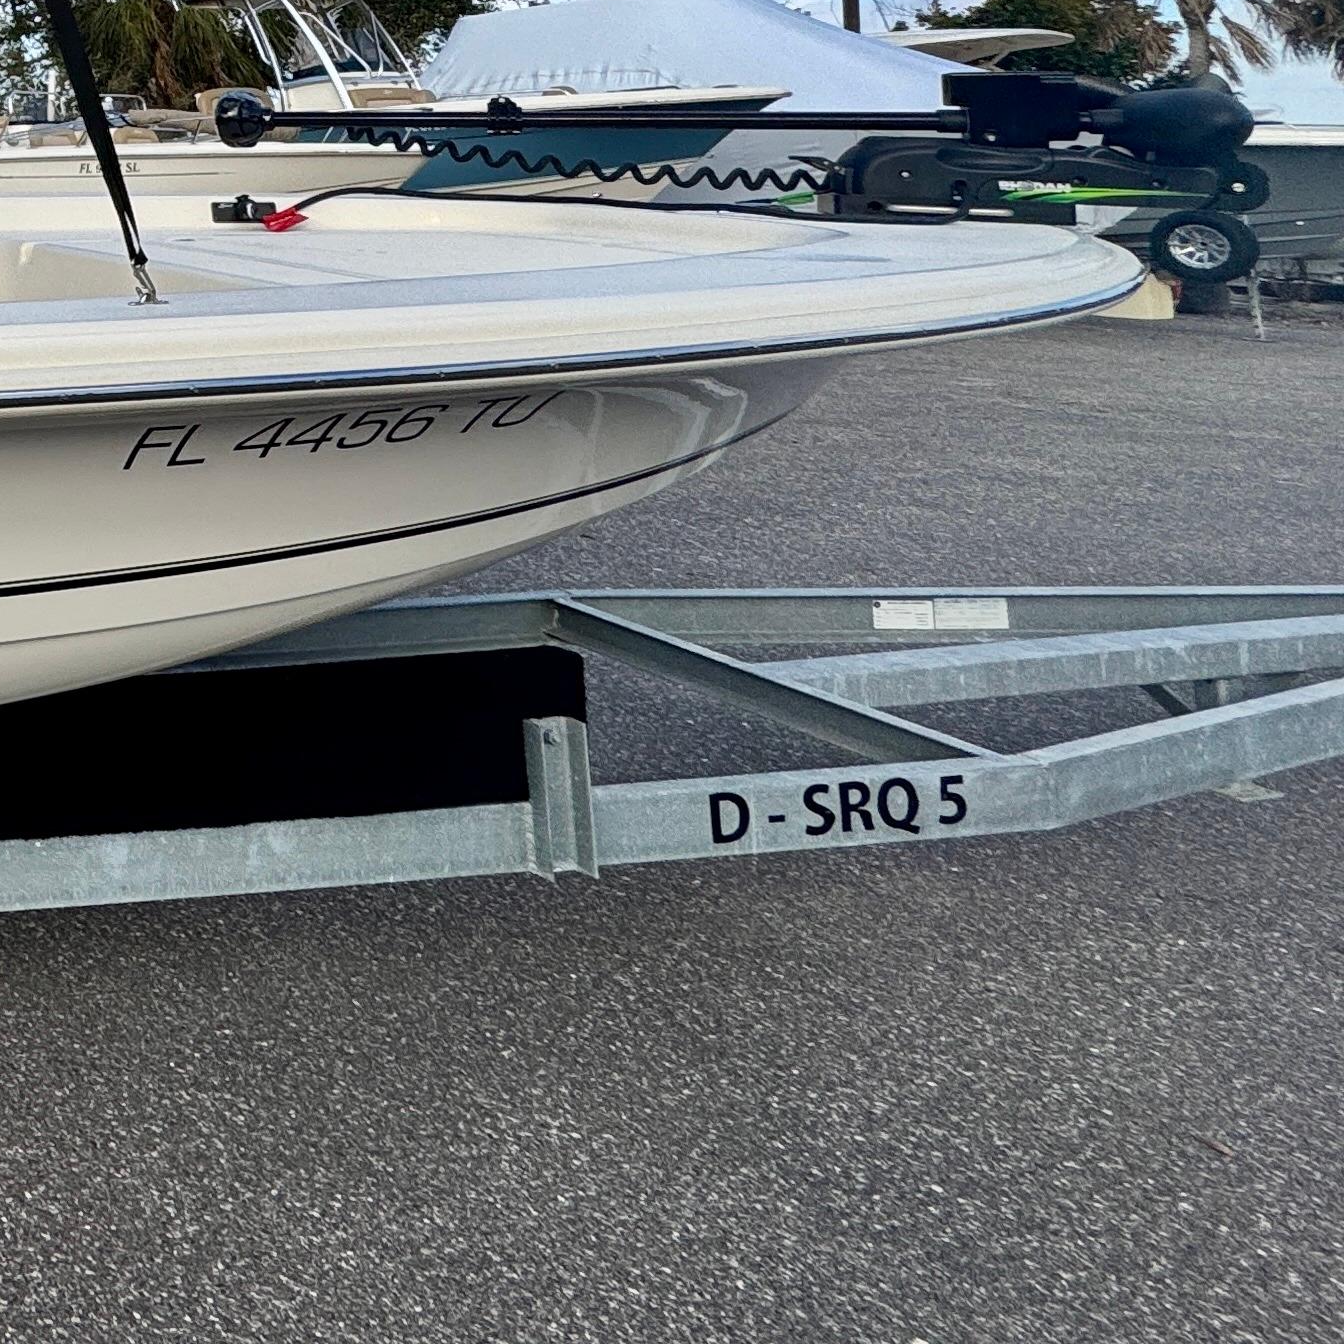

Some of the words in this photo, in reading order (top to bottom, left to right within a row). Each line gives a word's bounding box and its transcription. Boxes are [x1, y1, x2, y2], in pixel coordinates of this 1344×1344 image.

[123, 423, 206, 470] FL
[233, 404, 450, 459] 4456
[459, 389, 567, 434] TU
[708, 791, 751, 844] D
[768, 814, 786, 824] -
[802, 777, 921, 836] SRQ
[938, 774, 968, 825] 5
